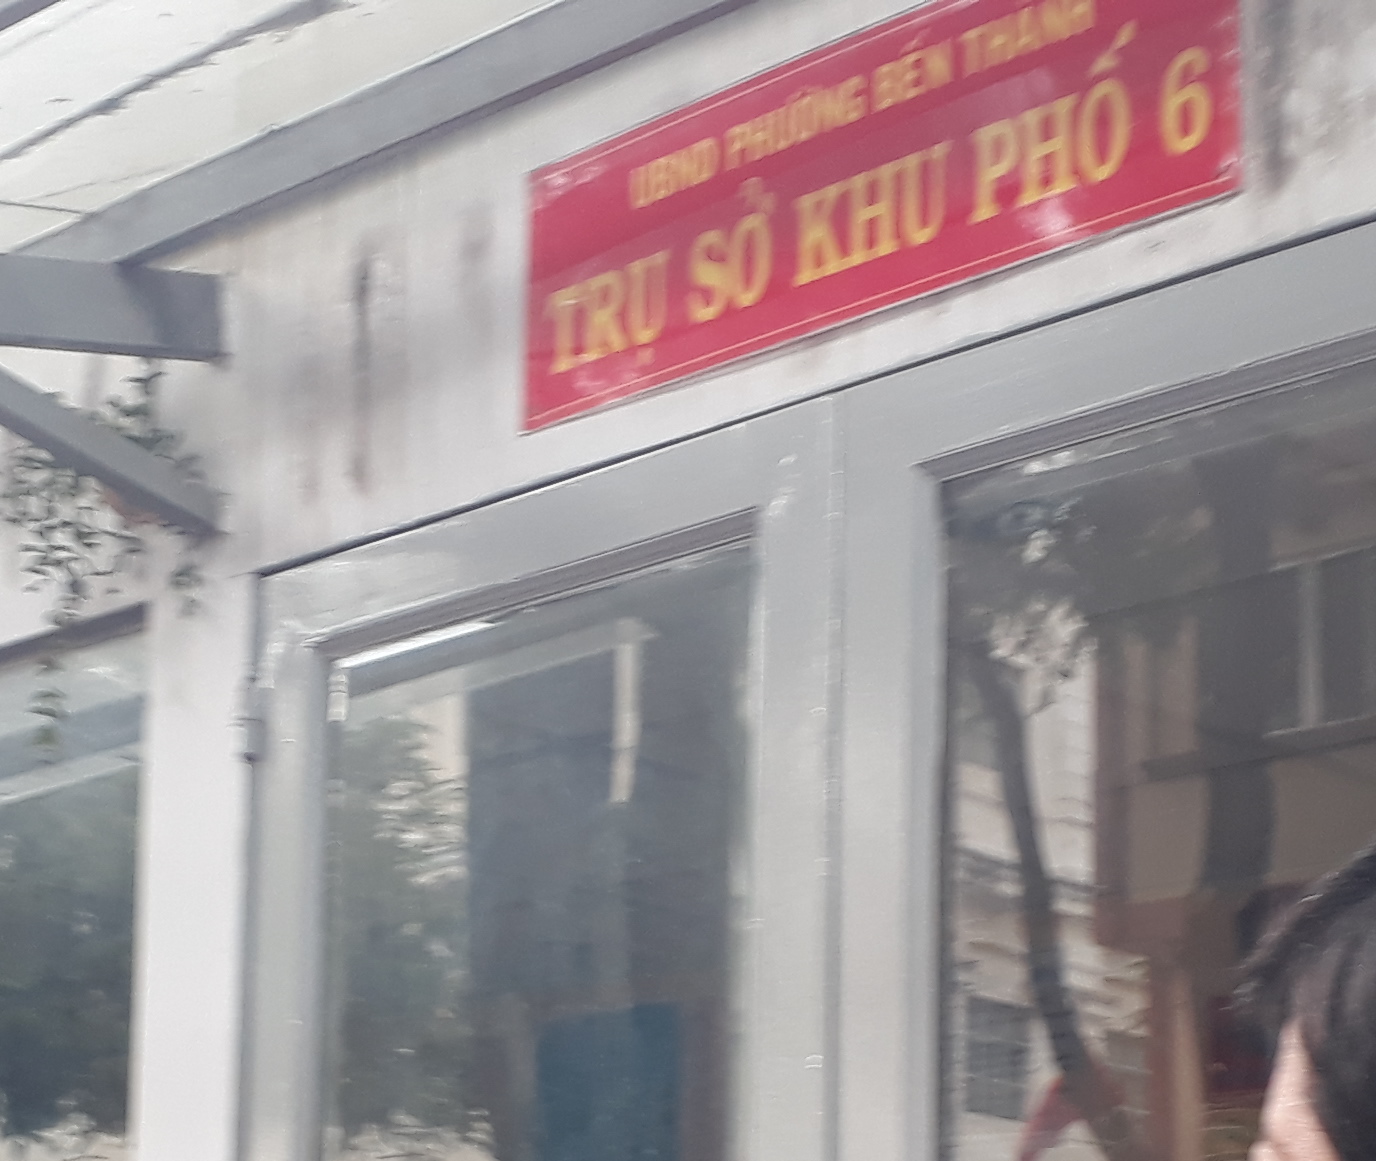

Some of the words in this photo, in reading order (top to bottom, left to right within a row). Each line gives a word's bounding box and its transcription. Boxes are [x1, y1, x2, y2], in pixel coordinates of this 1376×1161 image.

[548, 249, 671, 374] TRỤ
[687, 176, 776, 324] SỞ
[791, 140, 956, 288] KHU
[966, 19, 1139, 225] PHỐ
[1160, 46, 1214, 156] 6
[629, 137, 720, 211] UBND
[724, 74, 870, 172] PHƯỜNG
[870, 27, 956, 115] BẾN
